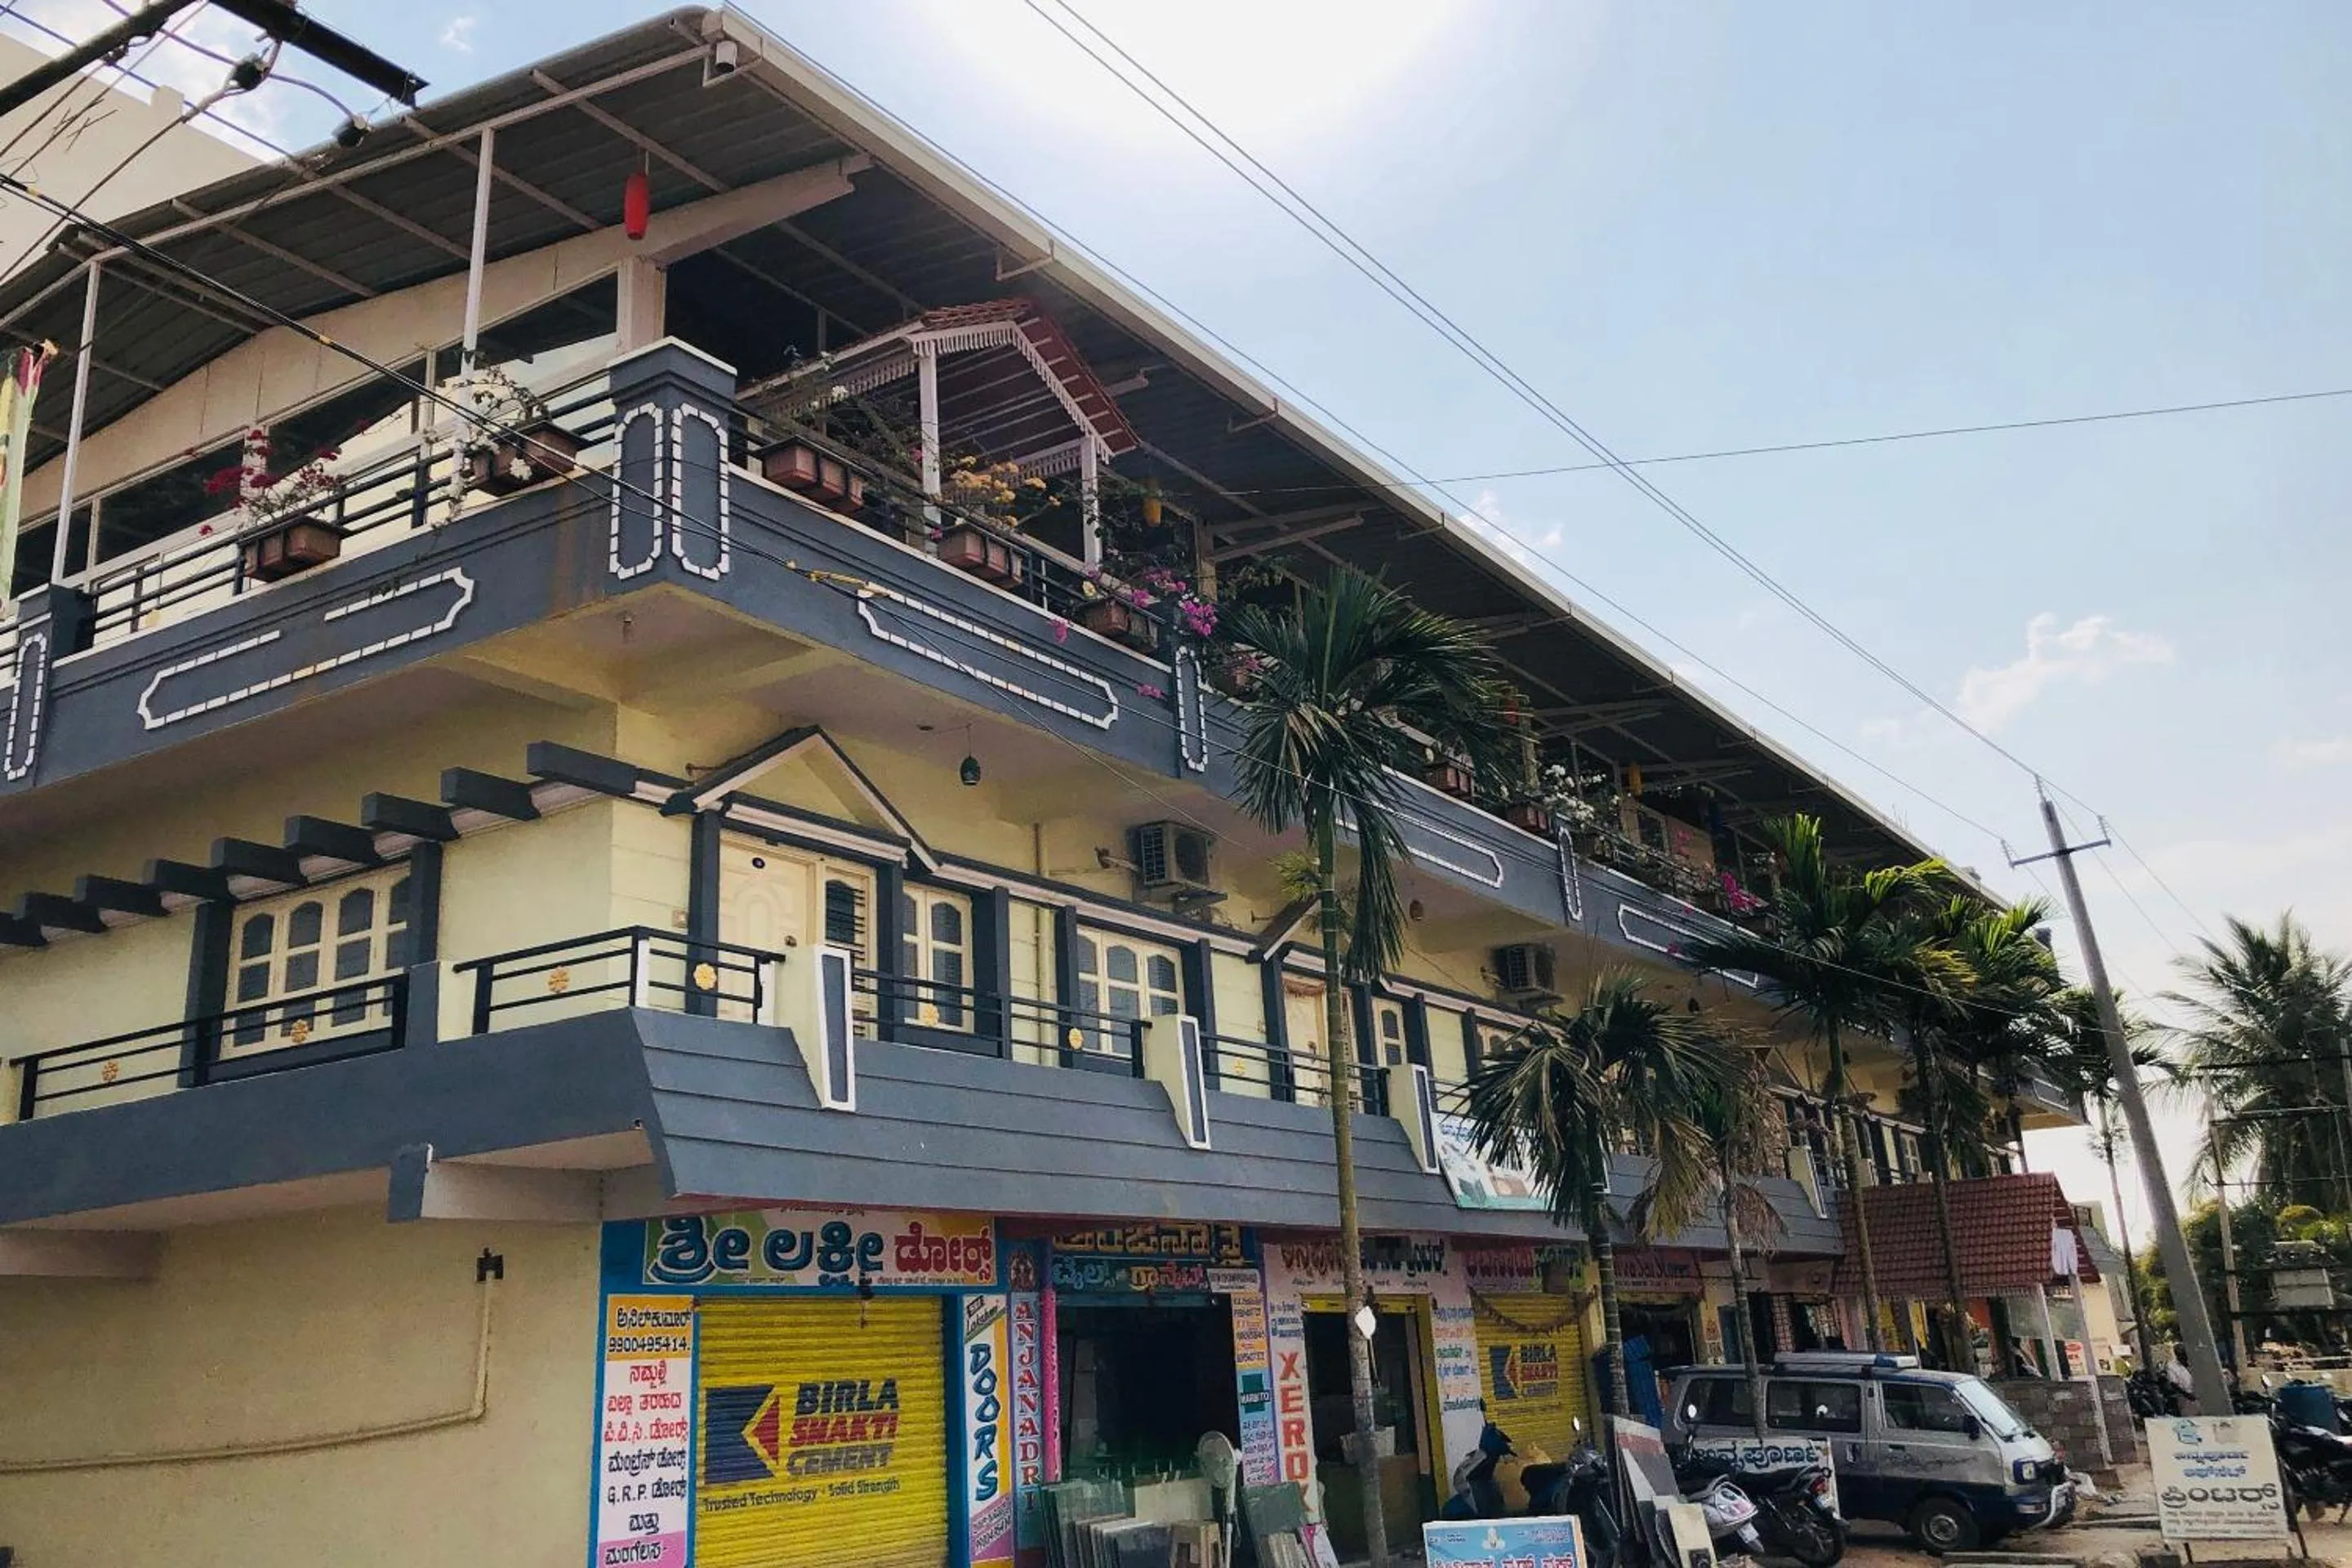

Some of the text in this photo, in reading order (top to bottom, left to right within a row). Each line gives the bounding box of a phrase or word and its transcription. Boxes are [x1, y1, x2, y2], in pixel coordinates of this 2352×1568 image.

[795, 1379, 899, 1415] BIRLA
[1016, 1301, 1040, 1512] ANJANADRI
[788, 1413, 899, 1448] SHAKTI
[969, 1343, 1001, 1501] DOORS
[786, 1442, 895, 1476] CEMENT
[703, 1493, 746, 1512] Trusted
[750, 1488, 817, 1509] Technology
[827, 1482, 855, 1497] Solid
